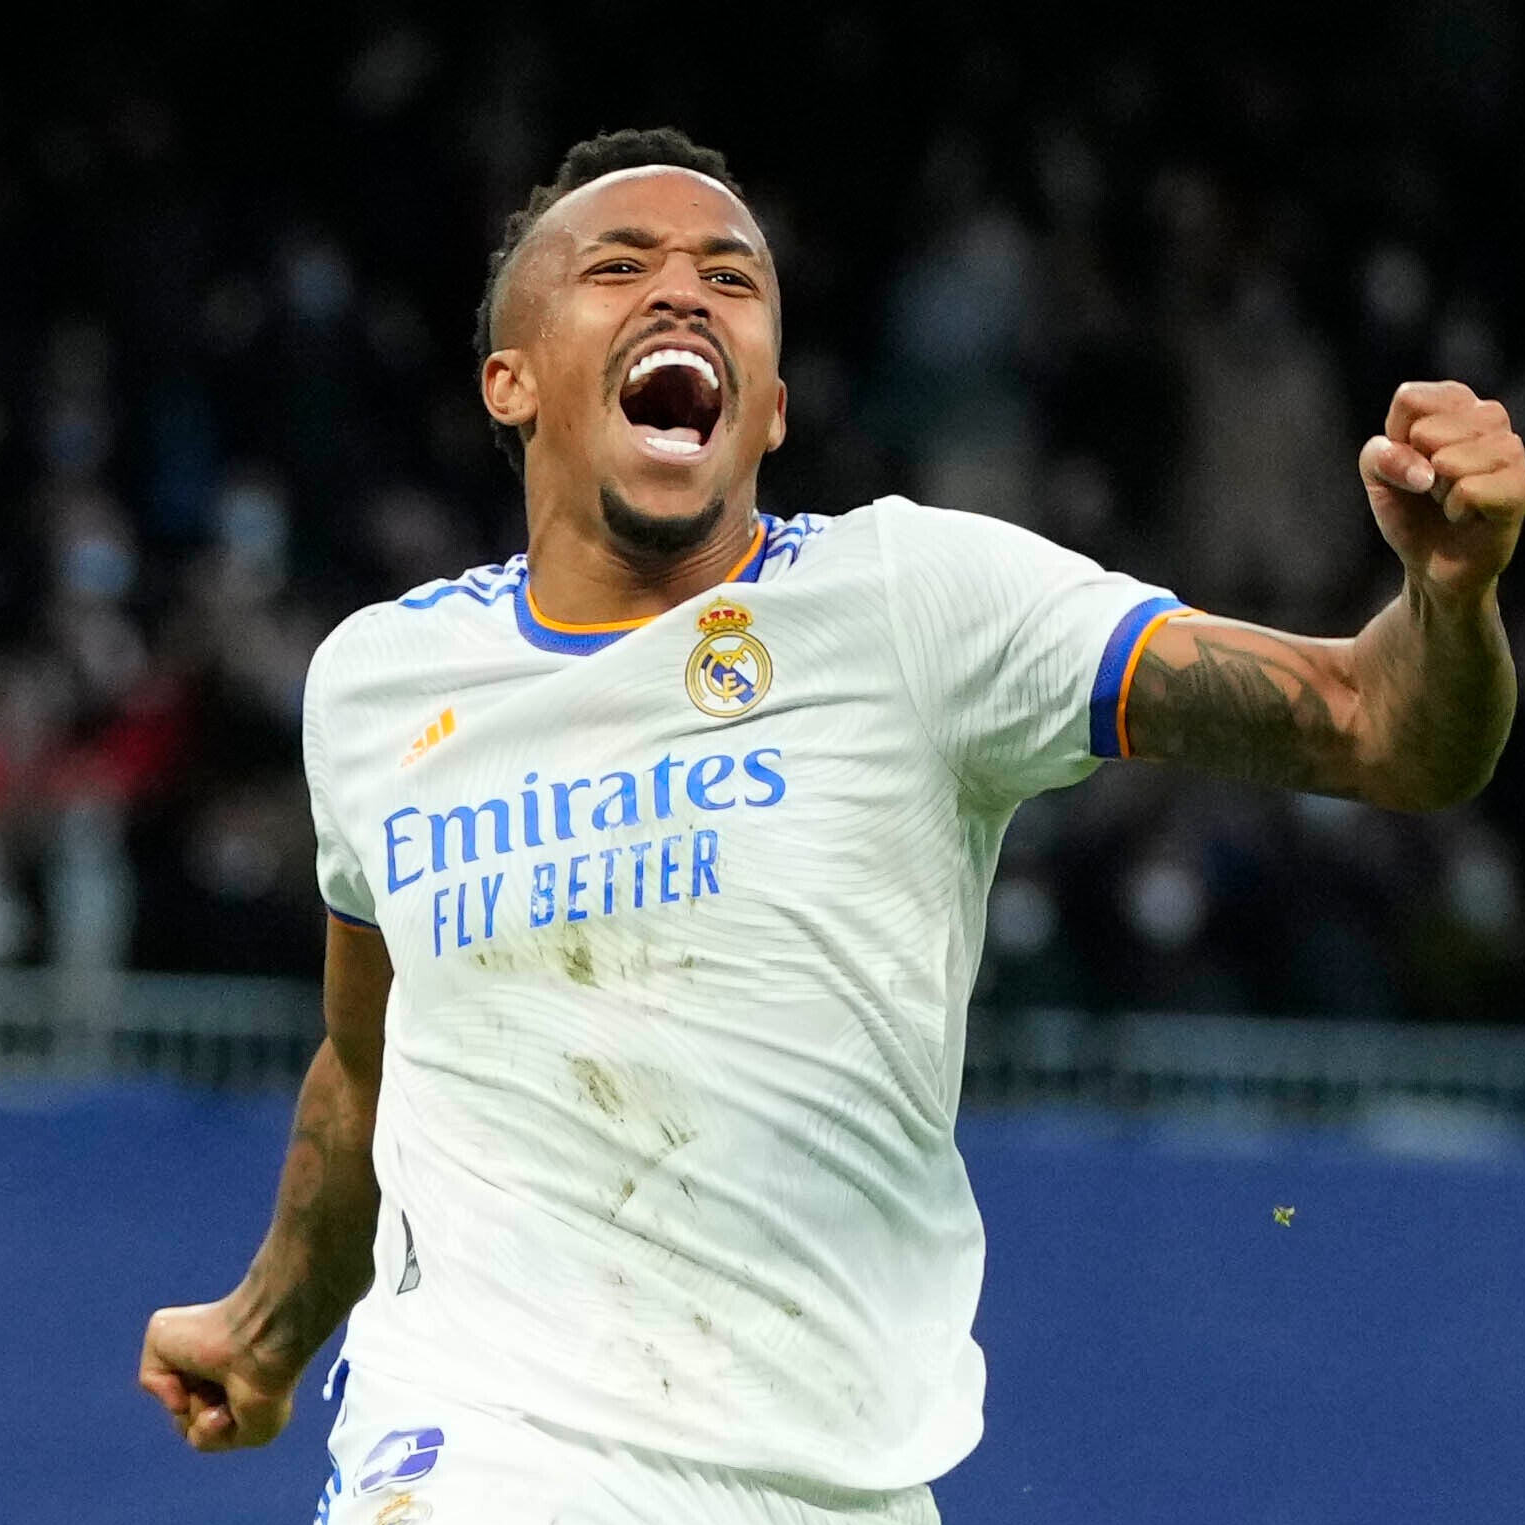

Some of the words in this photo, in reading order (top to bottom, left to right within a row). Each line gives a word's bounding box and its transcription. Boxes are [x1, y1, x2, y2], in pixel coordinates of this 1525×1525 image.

[384, 747, 786, 894] Emirates
[433, 870, 504, 957] FLY
[529, 828, 721, 928] BETTER
